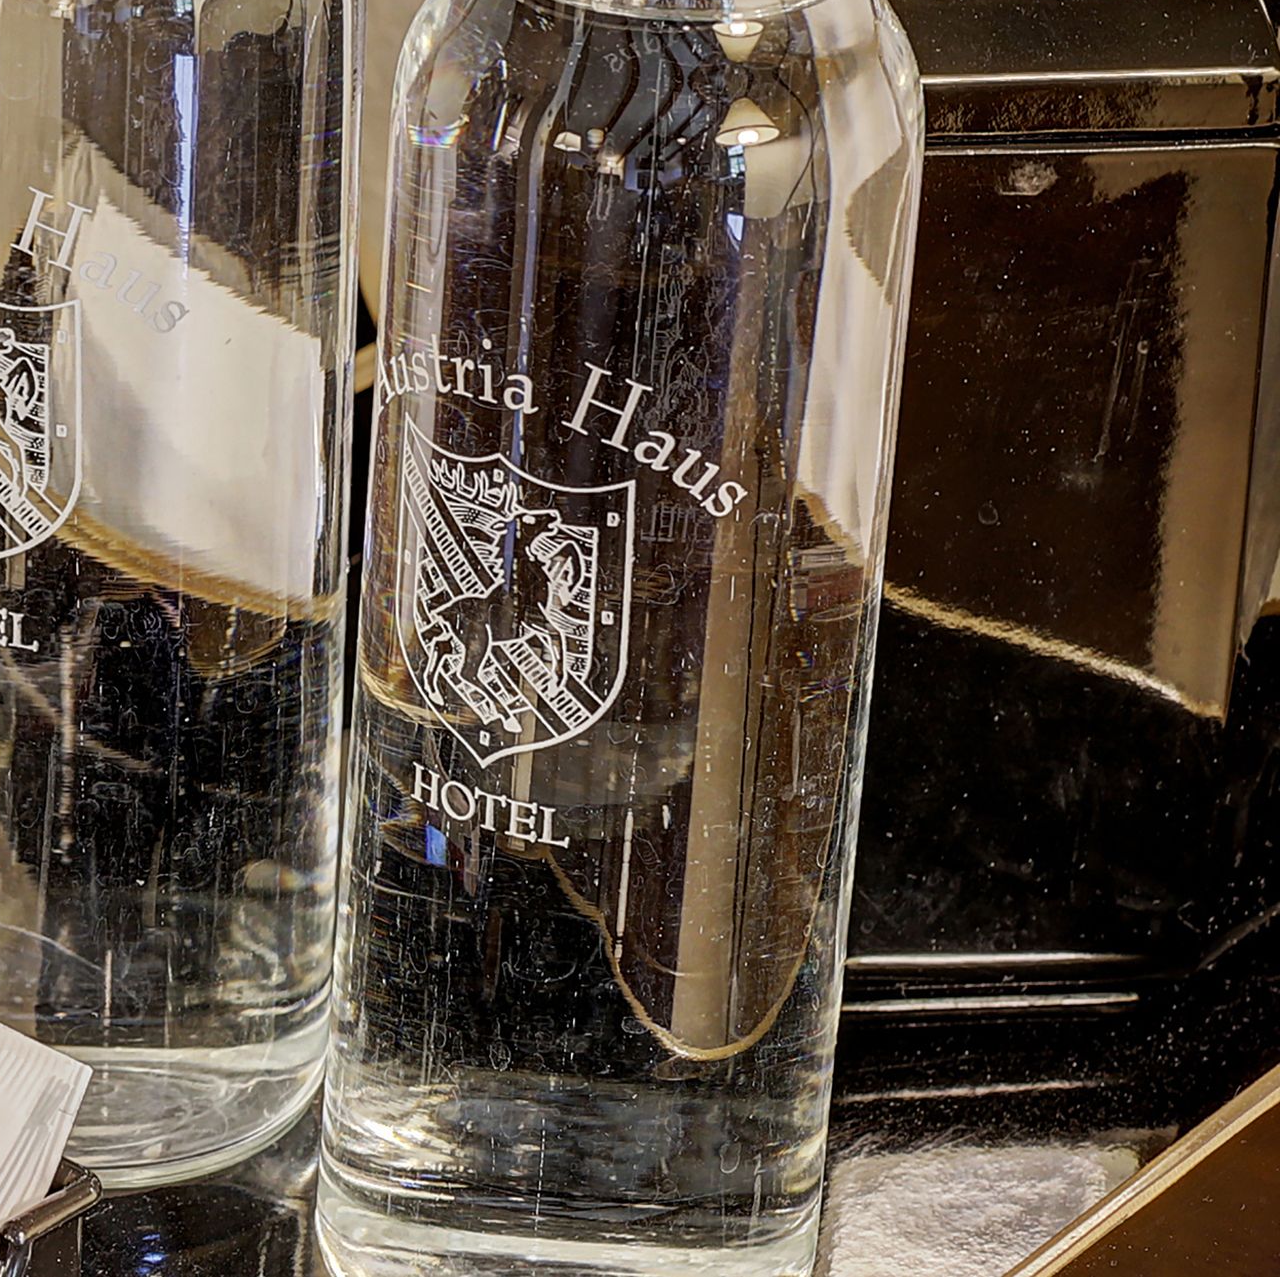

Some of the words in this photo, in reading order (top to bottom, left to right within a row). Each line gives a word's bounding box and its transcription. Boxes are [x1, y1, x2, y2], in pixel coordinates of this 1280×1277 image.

[10, 186, 190, 336] Haus
[561, 361, 748, 520] Haus
[410, 762, 570, 848] HOTEL
